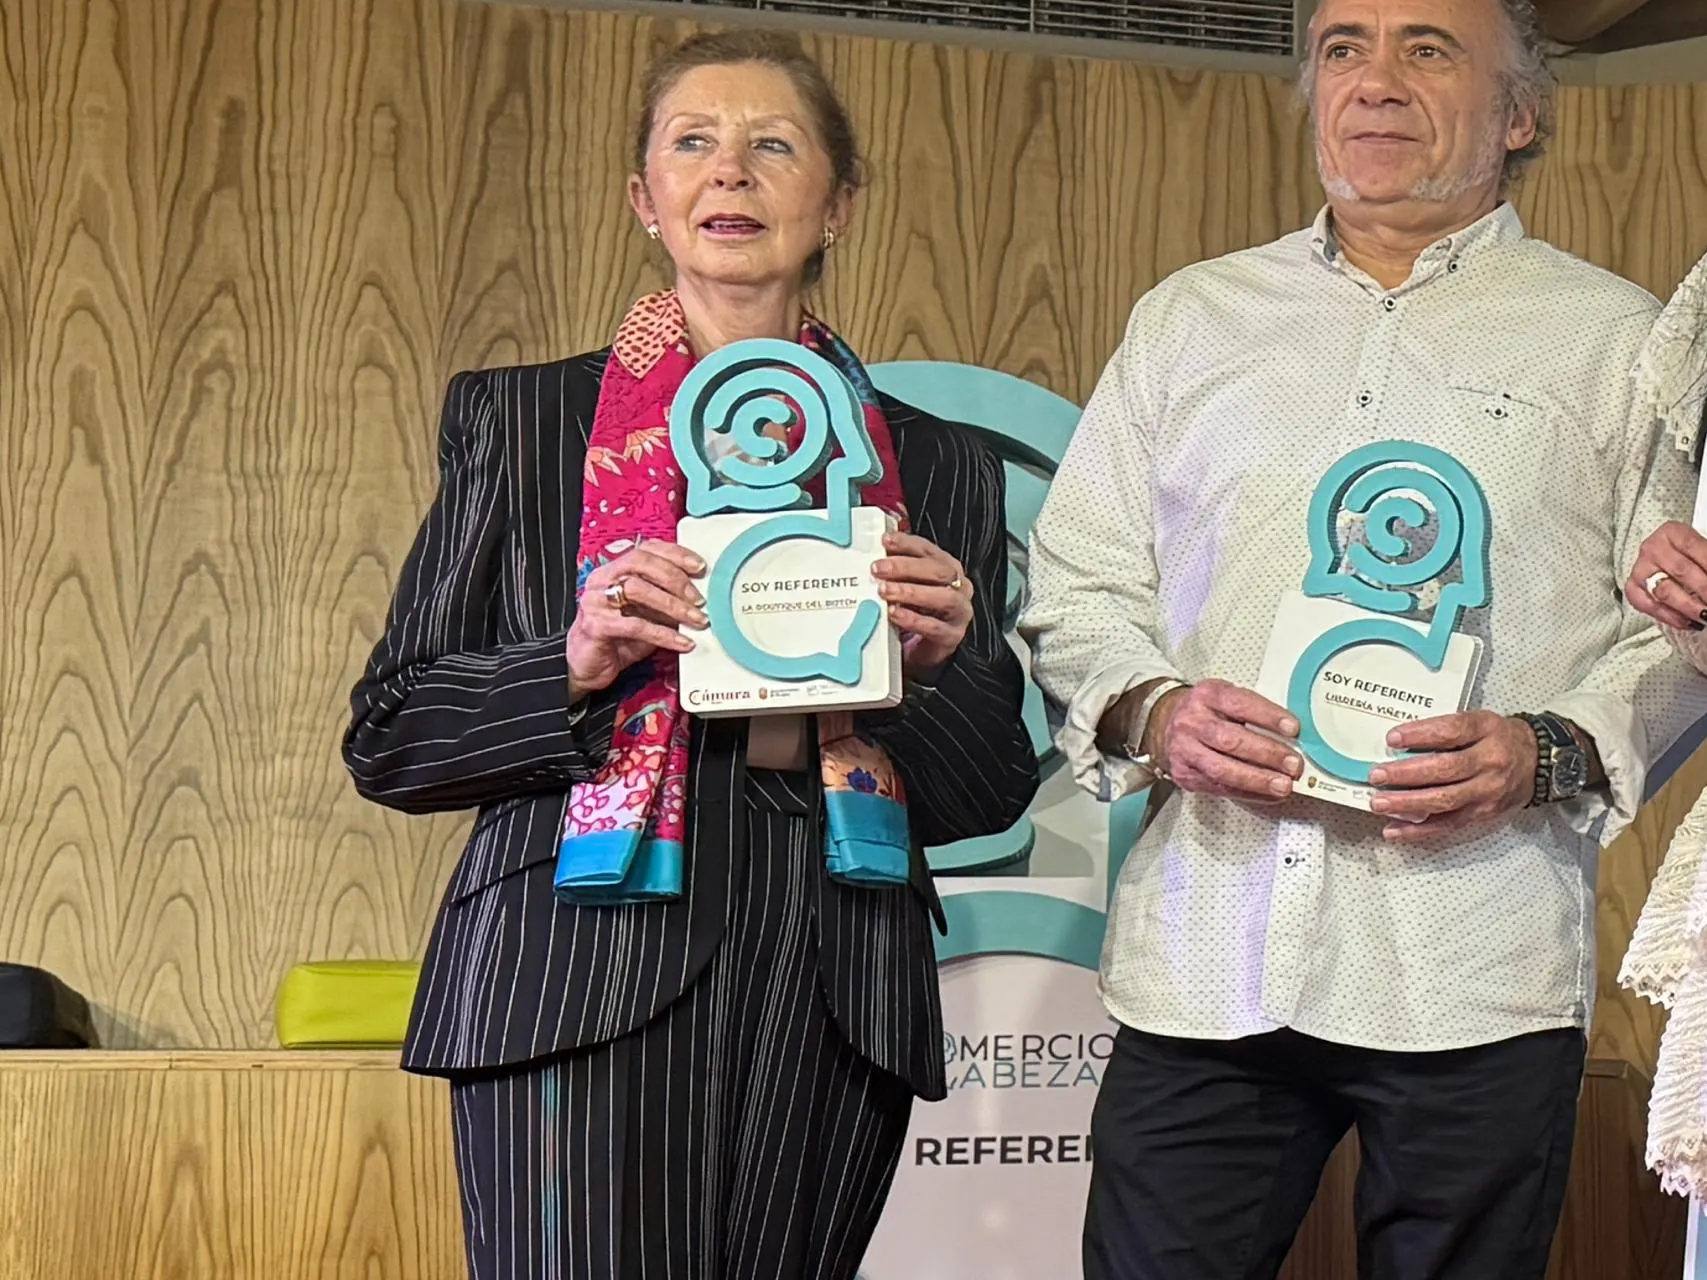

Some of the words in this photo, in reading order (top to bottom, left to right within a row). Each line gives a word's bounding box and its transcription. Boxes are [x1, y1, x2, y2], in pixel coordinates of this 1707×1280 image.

[742, 582, 770, 593] SOY
[775, 577, 859, 591] REFERENTE
[1323, 671, 1351, 686] SOY
[1354, 679, 1434, 708] REFERENTE
[947, 1061, 1099, 1090] ABEZA
